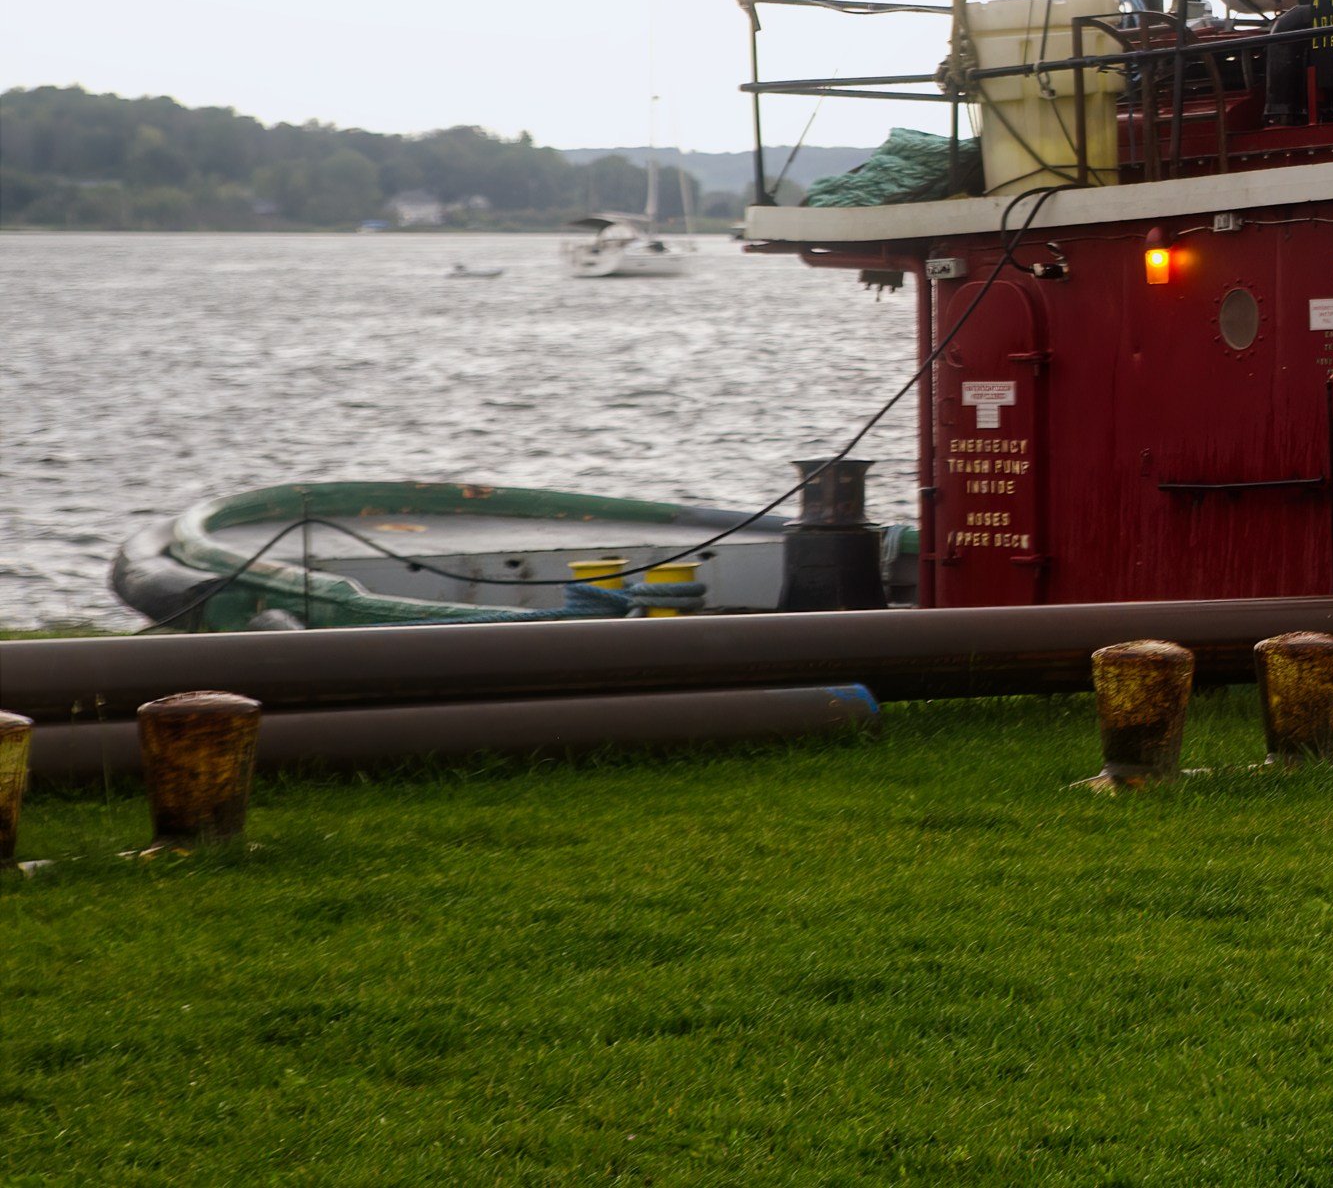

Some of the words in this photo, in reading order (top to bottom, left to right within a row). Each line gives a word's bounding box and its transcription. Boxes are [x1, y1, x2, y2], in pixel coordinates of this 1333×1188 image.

[949, 438, 1029, 455] EMERGENCY
[947, 458, 992, 474] TRASH
[994, 459, 1030, 475] PUMP
[966, 479, 1016, 494] INSIDE
[966, 512, 1011, 527] HOSES
[993, 532, 1030, 550] DECK
